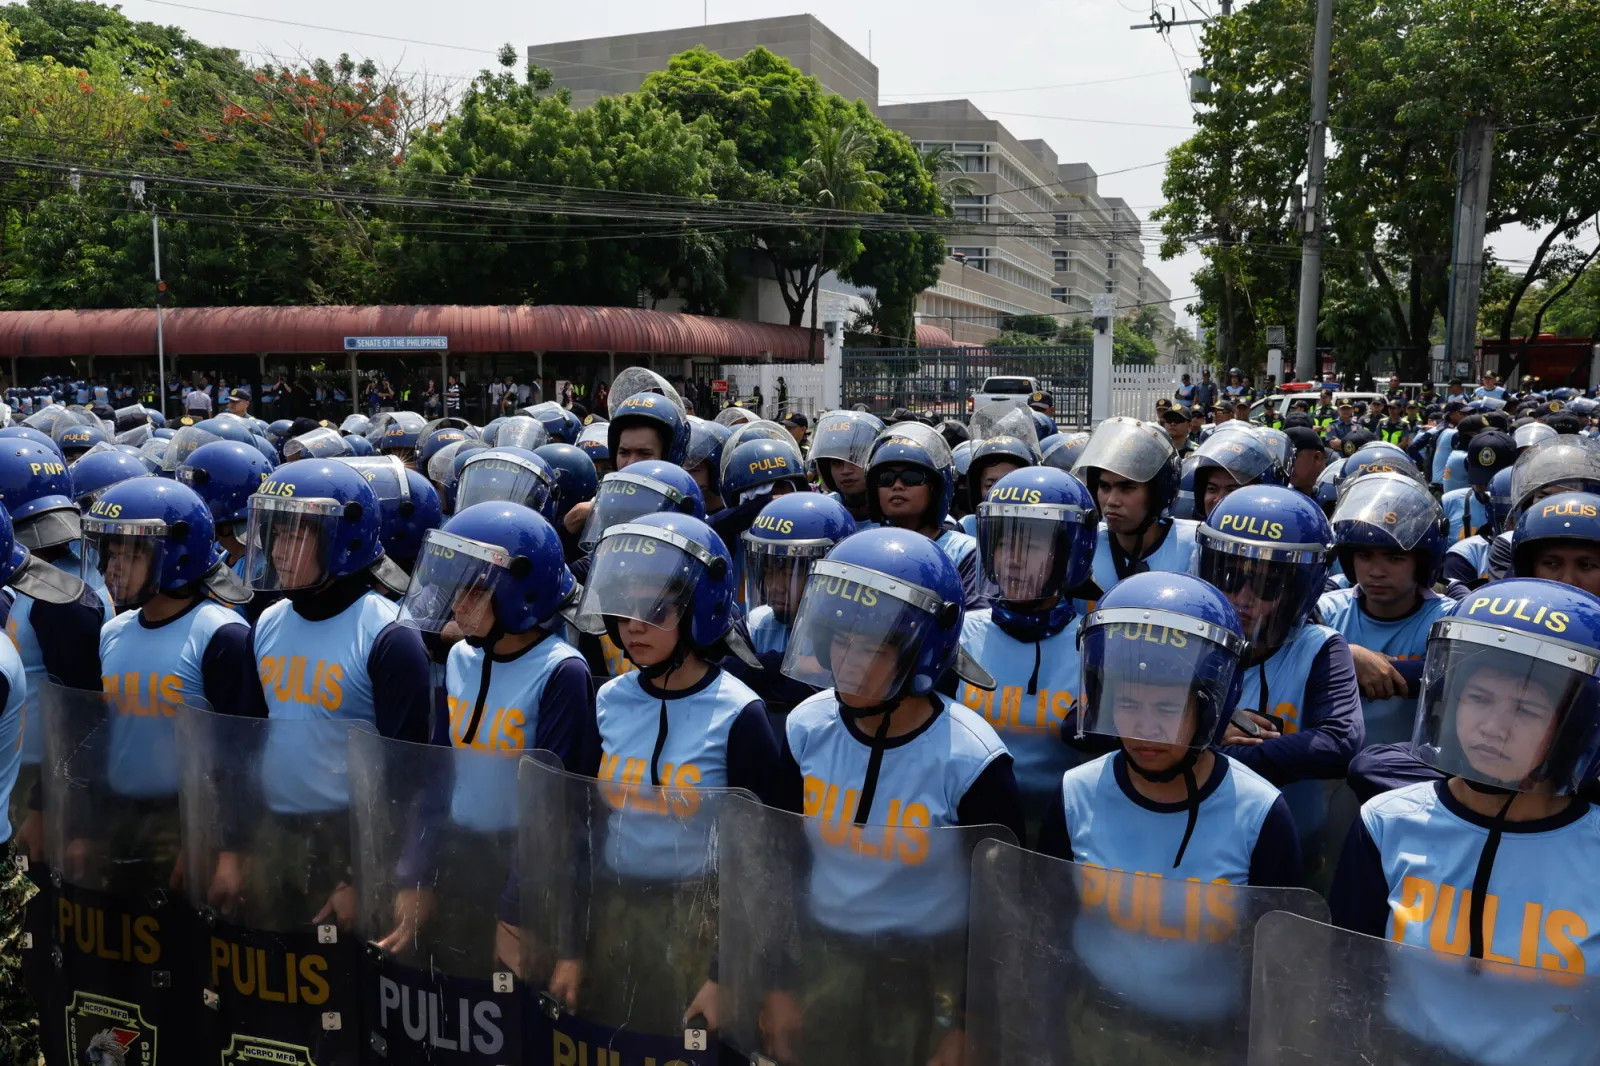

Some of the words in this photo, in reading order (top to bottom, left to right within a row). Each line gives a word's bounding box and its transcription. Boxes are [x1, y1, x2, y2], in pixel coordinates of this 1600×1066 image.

[357, 339, 381, 348] SENATE
[382, 339, 392, 347] OF
[393, 339, 405, 347] THE
[406, 339, 446, 347] PHILIPPINES
[63, 434, 91, 442] PULIS
[30, 462, 65, 476] PNP
[749, 456, 787, 474] PULIS
[602, 481, 637, 496] ULIS
[989, 487, 1042, 504] PULIS
[1542, 504, 1599, 518] PULIS
[752, 516, 794, 534] PULIS
[1219, 514, 1284, 540] PULIS
[428, 546, 456, 560] ULIS
[816, 577, 880, 608] PULIS
[1468, 597, 1570, 633] PULIS
[1107, 622, 1189, 649] PULIS
[261, 655, 344, 712] PULIS
[962, 683, 1075, 735] PULIS
[1082, 860, 1238, 943] PULIS
[58, 897, 162, 964] PULIS
[1393, 875, 1589, 986] PULIS
[210, 936, 331, 1006] PULIS
[84, 1003, 109, 1015] NCRPO
[110, 1009, 129, 1020] MFB
[379, 975, 505, 1056] PULIS
[245, 1047, 274, 1059] NCRPO
[275, 1052, 297, 1064] MFB
